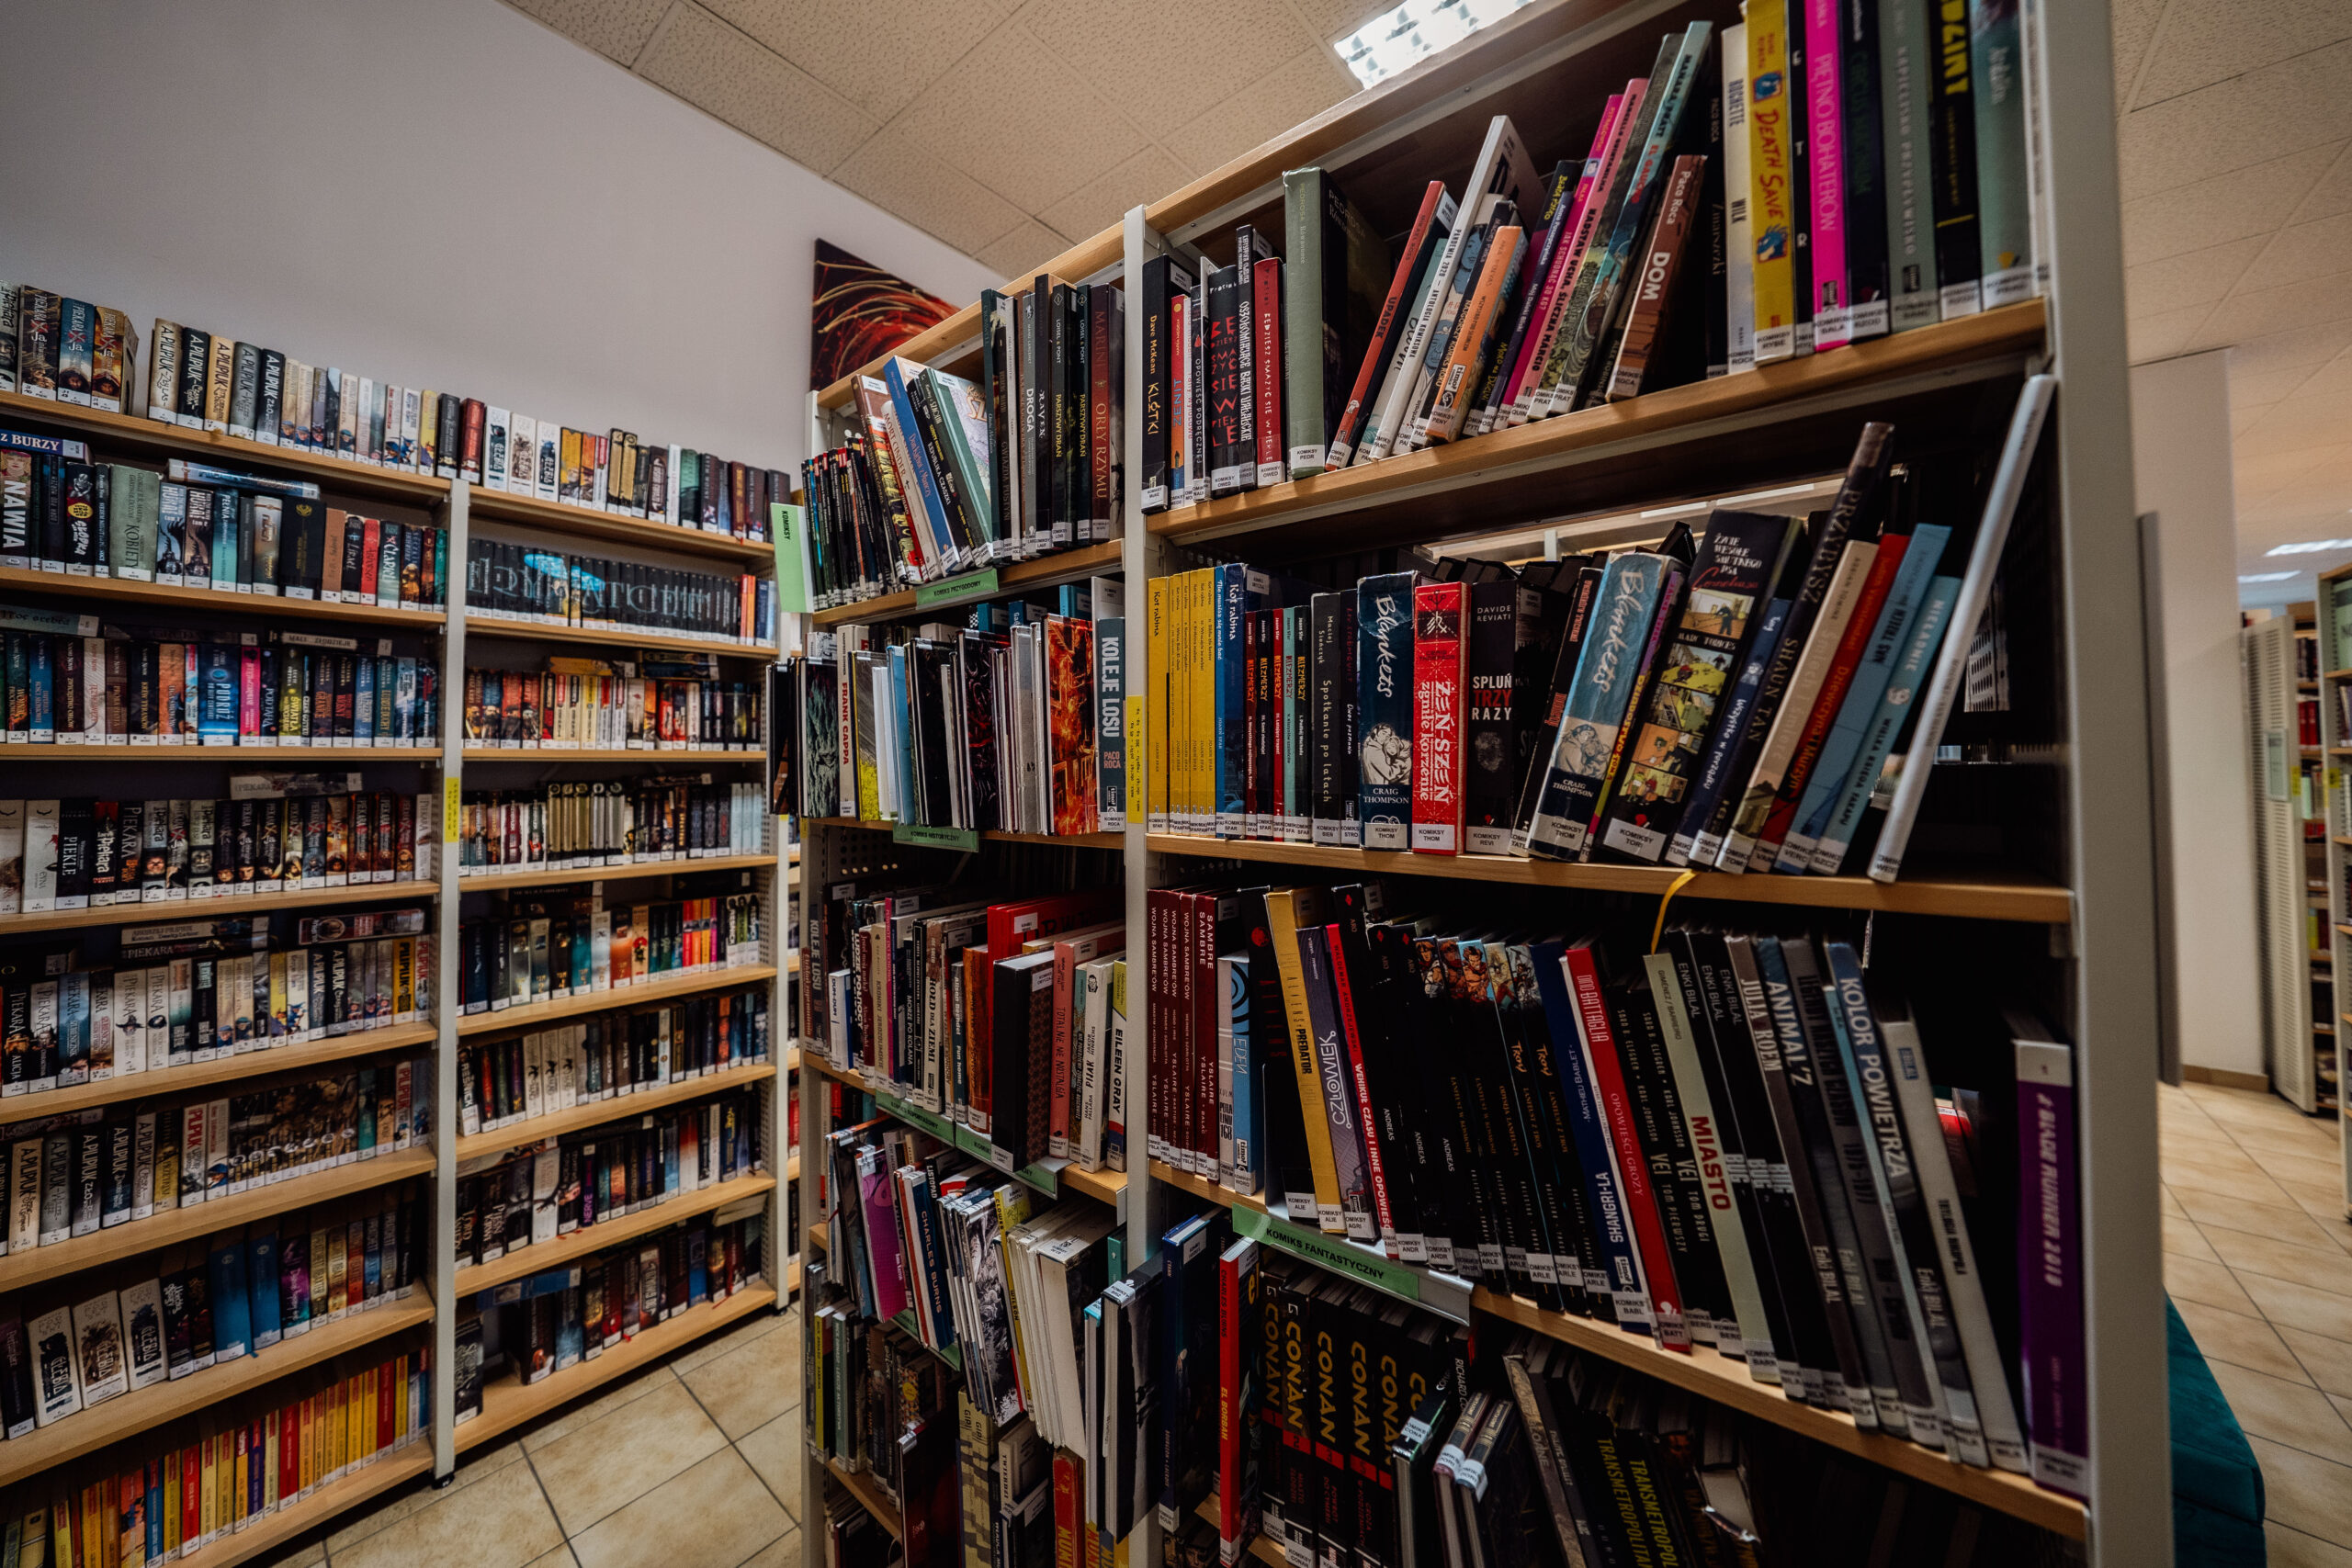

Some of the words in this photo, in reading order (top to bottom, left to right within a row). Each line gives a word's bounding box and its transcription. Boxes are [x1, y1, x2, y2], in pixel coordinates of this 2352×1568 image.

[1728, 78, 1744, 127] ROCHETTE
[1756, 109, 1782, 169] DEATH
[1674, 171, 1691, 197] Paco
[1761, 174, 1784, 219] SAVE
[1666, 198, 1683, 225] Roca
[1732, 198, 1747, 223] WILK
[1445, 229, 1462, 259] PANDEMIA
[1578, 209, 1597, 256] NADSTAW
[1438, 262, 1450, 277] 2020
[1642, 252, 1670, 300] DOM
[1375, 297, 1397, 339] UPADEK
[1424, 289, 1439, 321] ANTOLOGIA
[1409, 321, 1425, 358] KOMIKSOWA
[1026, 388, 1035, 434] DROGA
[1173, 378, 1182, 427] ZENIT
[1213, 394, 1238, 413] W
[12, 434, 60, 451] BURZY
[1096, 446, 1107, 500] RZYMU
[1215, 475, 1235, 483] KOMIKSY
[3, 480, 26, 548] NAWIA
[781, 511, 791, 540] KOMIKSY
[1801, 488, 1861, 604] PRZYBYSZ
[1229, 584, 1239, 603] Kot
[1477, 604, 1511, 615] DAVIDE
[1476, 613, 1511, 623] REVIATI
[1592, 570, 1645, 694] Blankets
[1102, 637, 1119, 693] KOLEJE
[1375, 595, 1397, 700] Blankets
[1472, 673, 1512, 690] SPLUŃ
[1765, 637, 1799, 698] SHAUN
[1102, 697, 1119, 738] LOSU
[1323, 680, 1332, 739] Spotkanie
[1471, 706, 1512, 721] RAZY
[1474, 690, 1512, 707] TRZY
[1747, 708, 1772, 741] TAN
[1103, 751, 1120, 760] PACO
[1103, 759, 1121, 769] ROCA
[1323, 745, 1329, 759] po
[1420, 730, 1430, 802] korzenie
[1363, 795, 1409, 806] THOMPSON
[1373, 787, 1399, 796] CRAIG
[1552, 783, 1594, 798] THOMPSON
[1562, 780, 1587, 790] CRAIG
[121, 807, 141, 858] PIEKARA
[1419, 829, 1445, 837] KOMIKSY
[1473, 832, 1501, 840] KOMIKSY
[1551, 820, 1583, 836] KOMIKSY
[1555, 829, 1576, 840] THOM
[1620, 828, 1653, 843] KOMIKSY
[1679, 962, 1690, 990] ENKI
[1686, 992, 1700, 1019] BILAL
[1702, 964, 1713, 989] ENKI
[1709, 993, 1724, 1021] BILAL
[1721, 969, 1733, 995] ENKI
[1728, 997, 1741, 1025] BILAL
[1741, 979, 1759, 1020] JULIA
[1114, 1027, 1123, 1071] EILEEN
[1233, 1037, 1248, 1075] EDEN
[1295, 1028, 1313, 1075] PREDATOR
[1085, 1060, 1094, 1089] PIJAK
[1840, 977, 1875, 1045] KOLOR
[1860, 1054, 1909, 1178] POWIETRZA
[1113, 1075, 1123, 1114] GRAY
[1383, 1108, 1395, 1141] ANDREAS
[1414, 1132, 1425, 1164] ANDREAS
[1442, 1138, 1453, 1172] ANDREAS
[1611, 1092, 1634, 1157] OPOWIEŚCI
[1628, 1161, 1643, 1198] GROZY
[1690, 1116, 1732, 1211] MIASTO
[926, 1164, 937, 1199] LISTOPAD
[1596, 1172, 1623, 1244] SHANGRI-LA
[922, 1210, 936, 1266] CHARLES
[930, 1270, 943, 1314] BURNS
[1266, 1228, 1303, 1248] KOMIKS
[1305, 1241, 1385, 1280] FANTASTYCZNY
[1264, 1303, 1281, 1406] CONAN
[1285, 1321, 1304, 1429] CONAN
[1317, 1330, 1337, 1444] CONAN
[1351, 1340, 1372, 1456] CONAN
